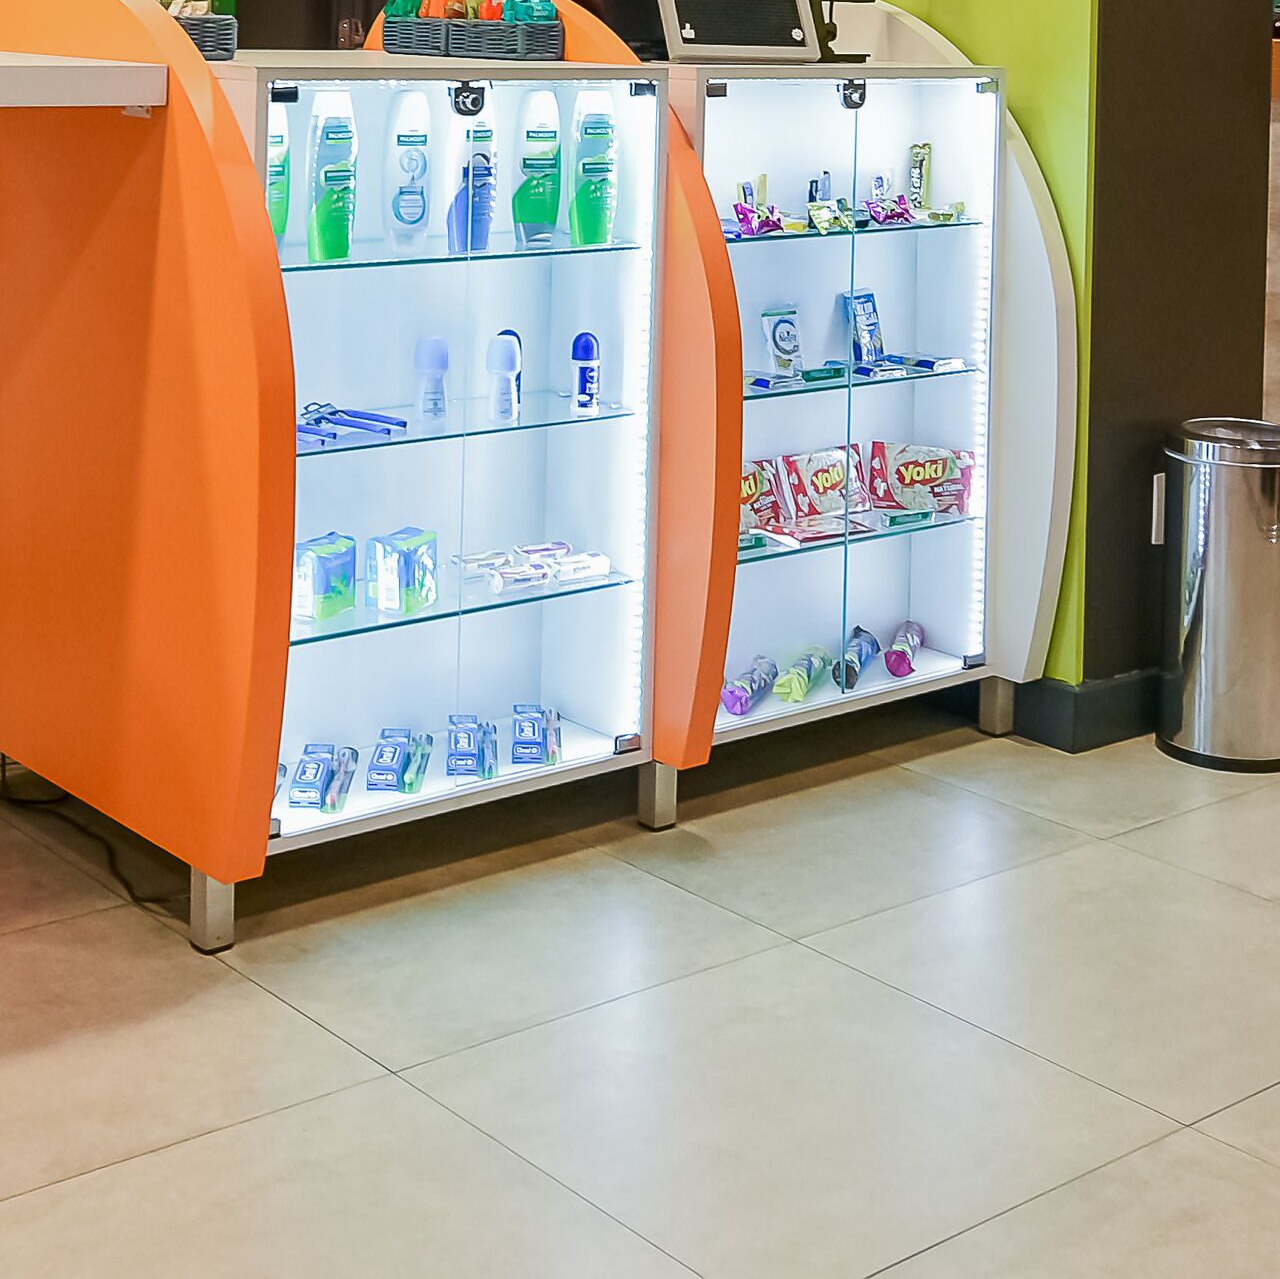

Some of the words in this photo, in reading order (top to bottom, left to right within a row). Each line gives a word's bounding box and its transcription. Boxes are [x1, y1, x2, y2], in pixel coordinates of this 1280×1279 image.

[811, 465, 844, 493] Yoki
[897, 461, 943, 483] Yoki
[741, 475, 756, 498] ki
